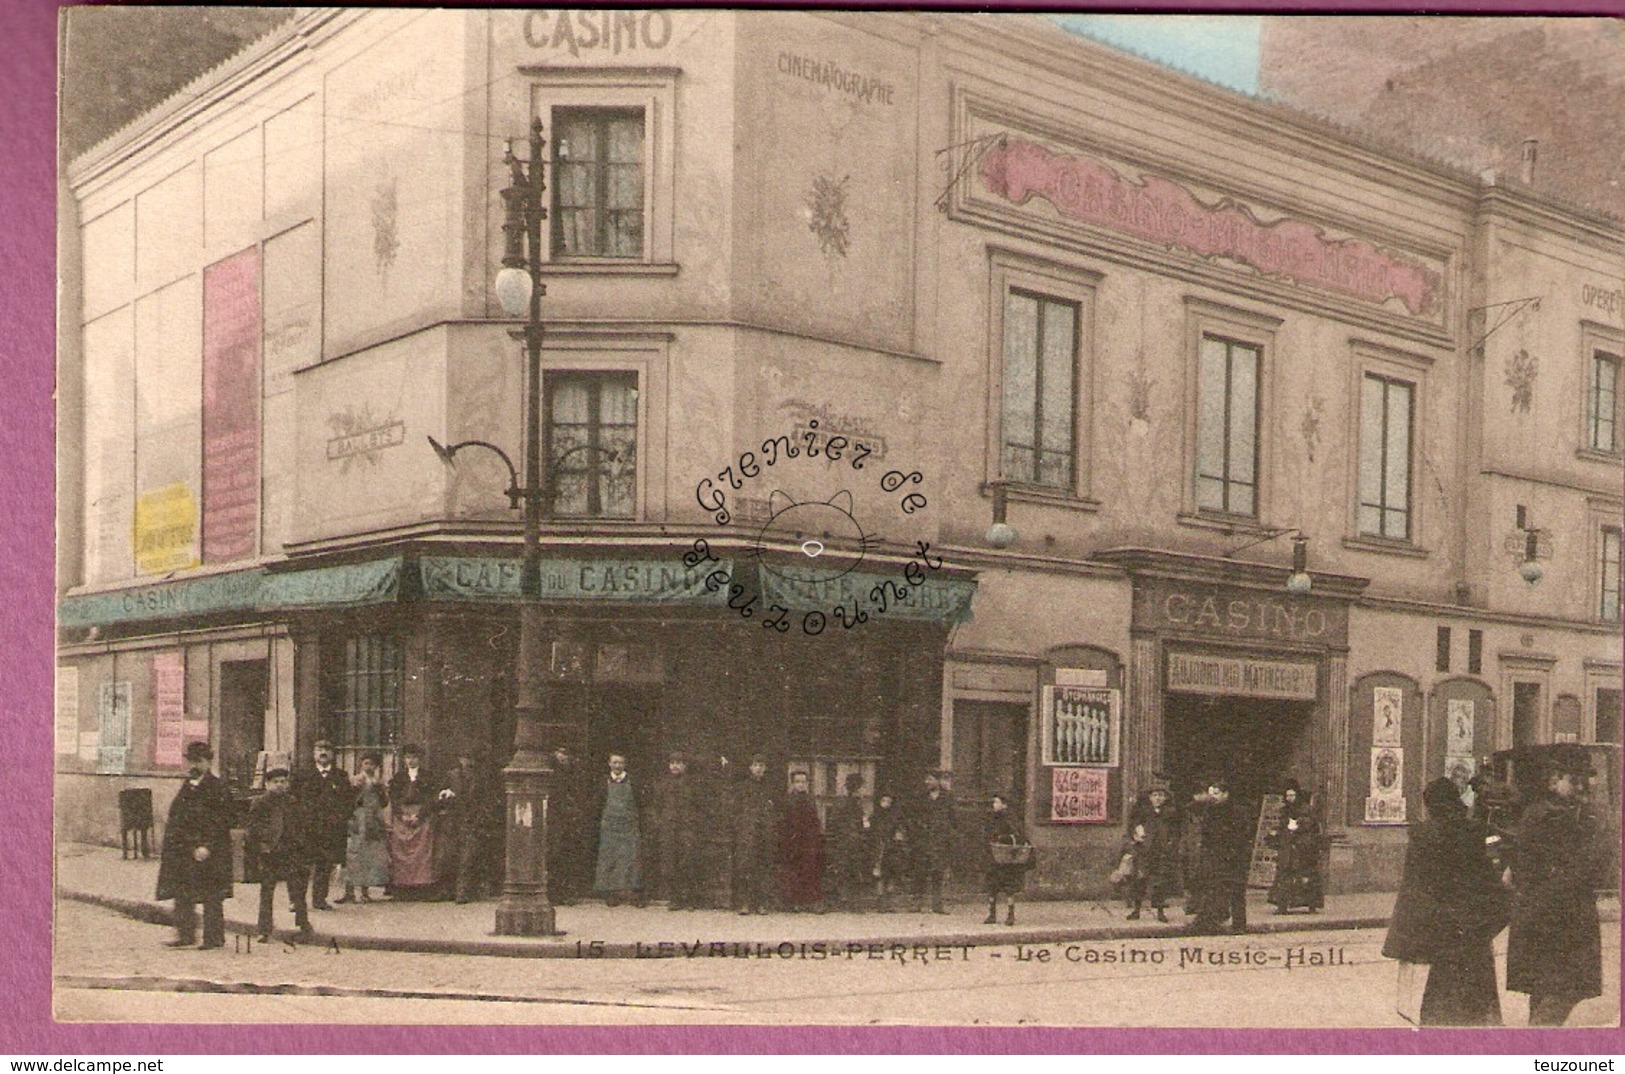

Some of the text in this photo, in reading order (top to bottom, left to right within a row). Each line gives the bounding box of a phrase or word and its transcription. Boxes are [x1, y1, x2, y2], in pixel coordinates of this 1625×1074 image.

[523, 10, 672, 58] CASINO
[778, 51, 894, 105] CINEMATOGRAPHE
[579, 565, 700, 592] CASINO
[1166, 593, 1326, 636] CASINO
